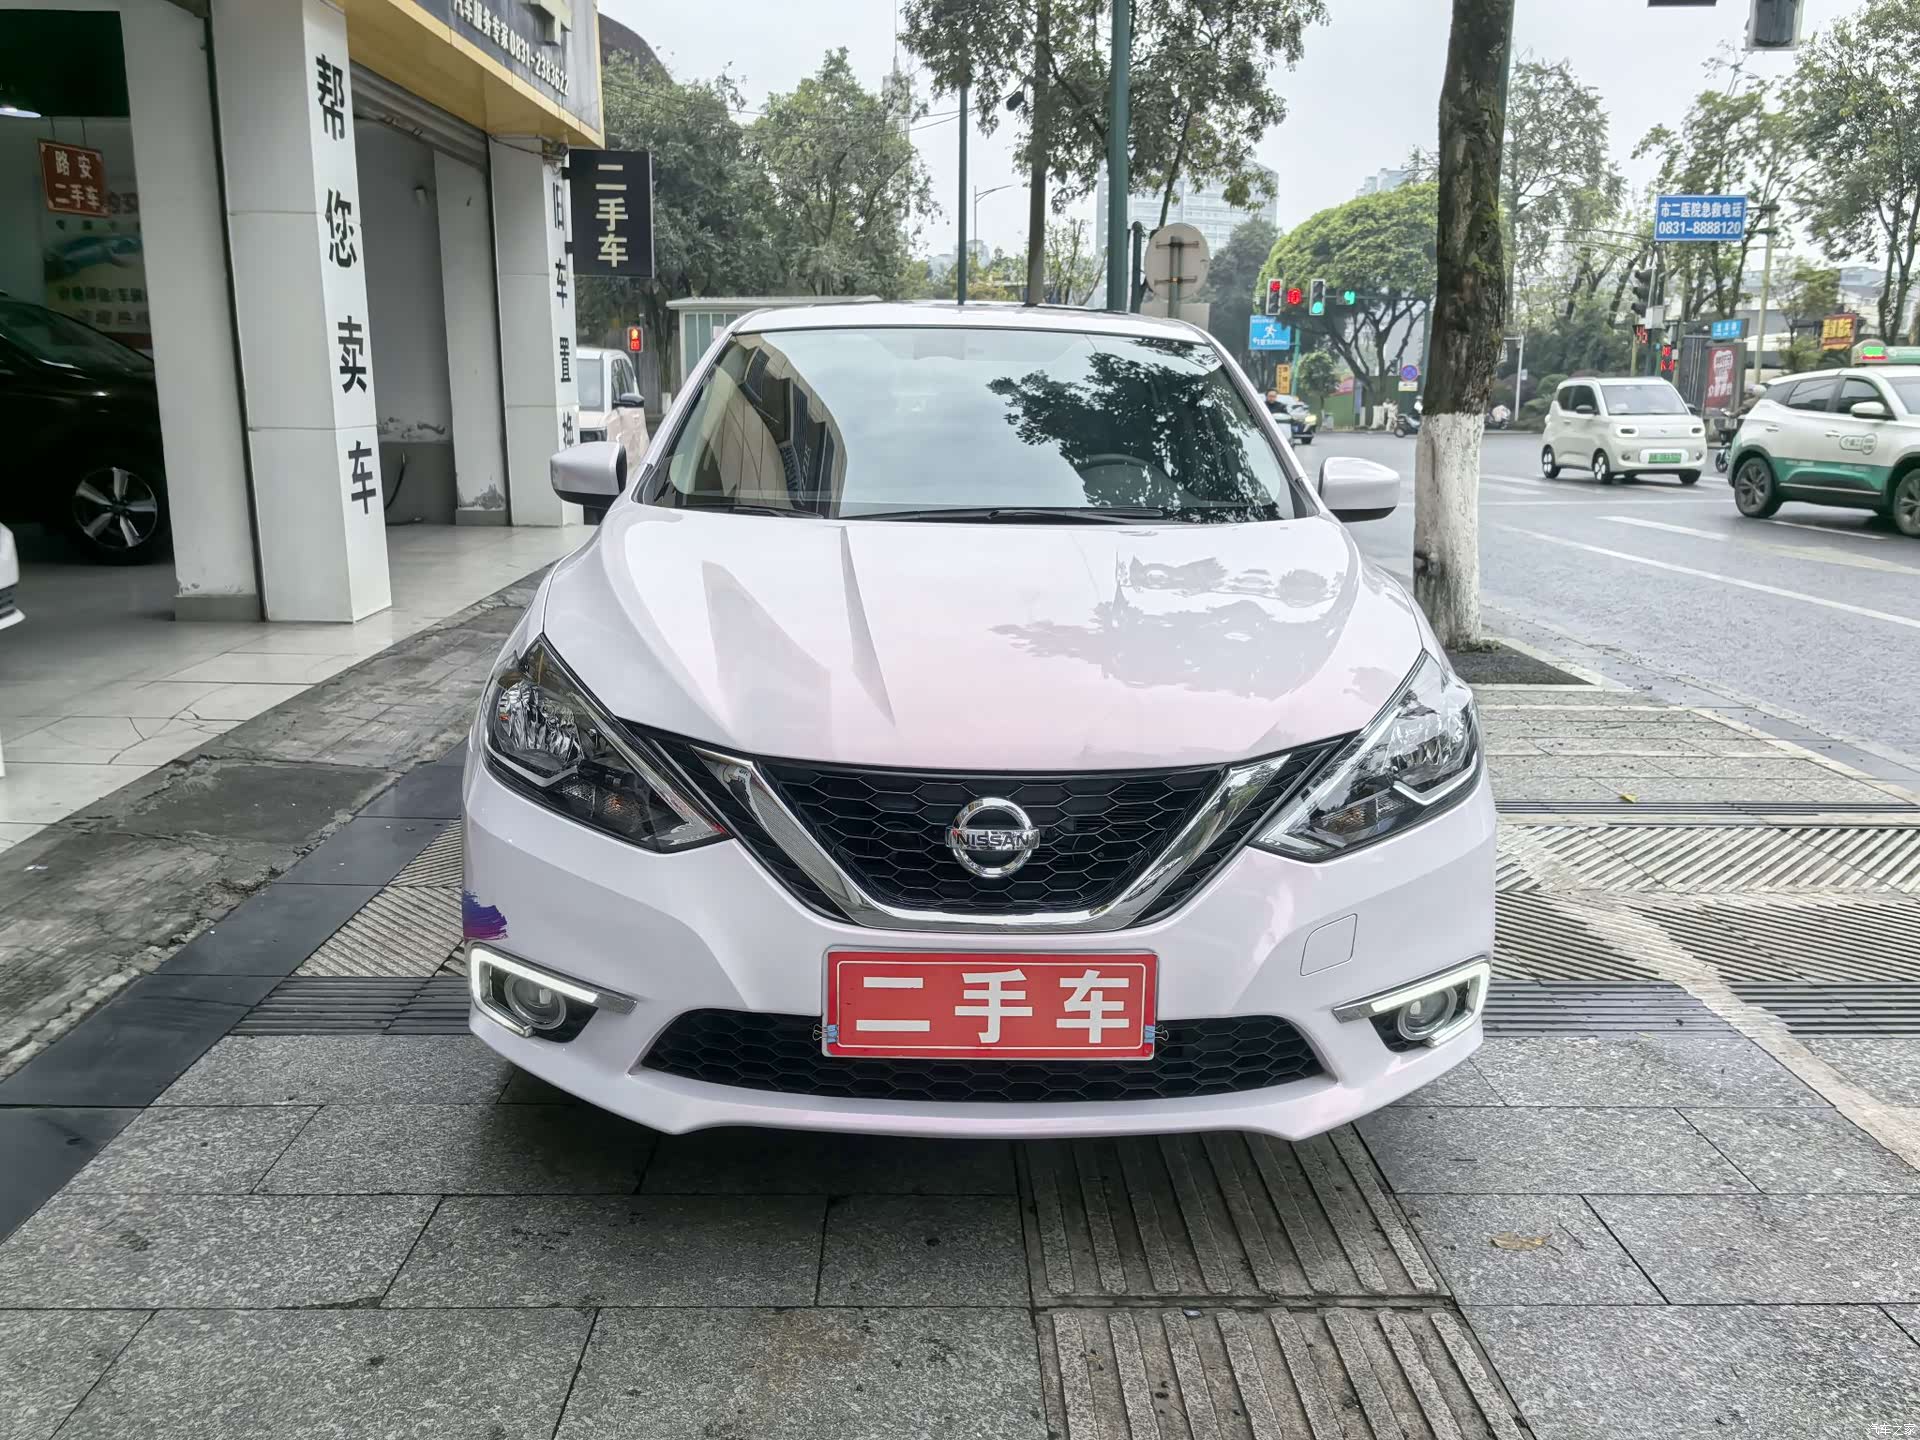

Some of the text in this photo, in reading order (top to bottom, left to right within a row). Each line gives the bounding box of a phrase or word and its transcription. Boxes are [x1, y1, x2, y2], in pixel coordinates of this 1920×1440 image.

[54, 151, 93, 180] 路安
[54, 182, 101, 210] 二手车
[1660, 201, 1743, 218] 市二医院急救电话
[595, 164, 629, 268] 二手车
[1659, 220, 1741, 235] 0831-8888120
[315, 53, 377, 515] 帮您卖车
[956, 833, 1030, 848] NISSAN
[856, 968, 1130, 1044] 二手车
